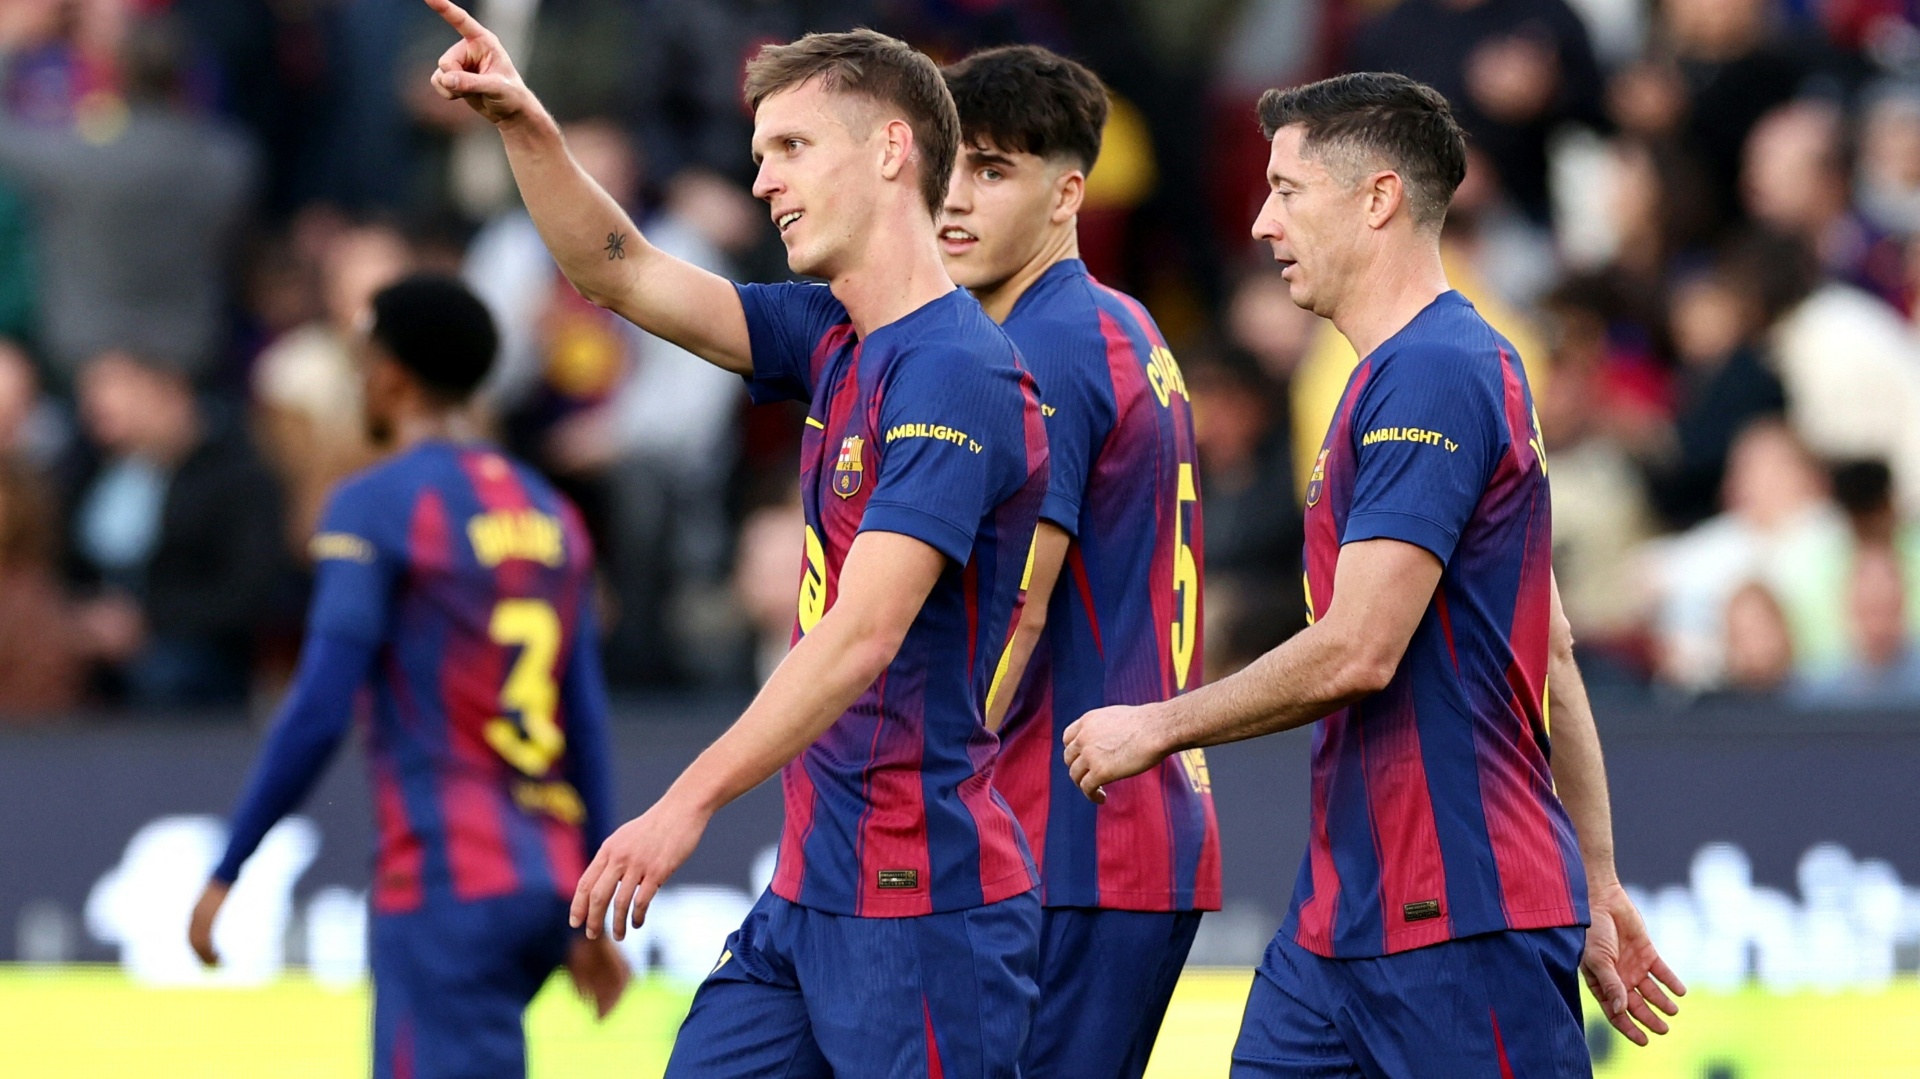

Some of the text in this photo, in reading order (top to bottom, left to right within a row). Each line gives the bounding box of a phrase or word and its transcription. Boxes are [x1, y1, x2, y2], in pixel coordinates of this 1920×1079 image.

[1041, 403, 1056, 417] tv
[886, 423, 983, 455] AMBILIGHT tv
[1362, 427, 1459, 453] AMBILIGHT tv
[1171, 463, 1198, 690] 5
[483, 598, 566, 777] 3
